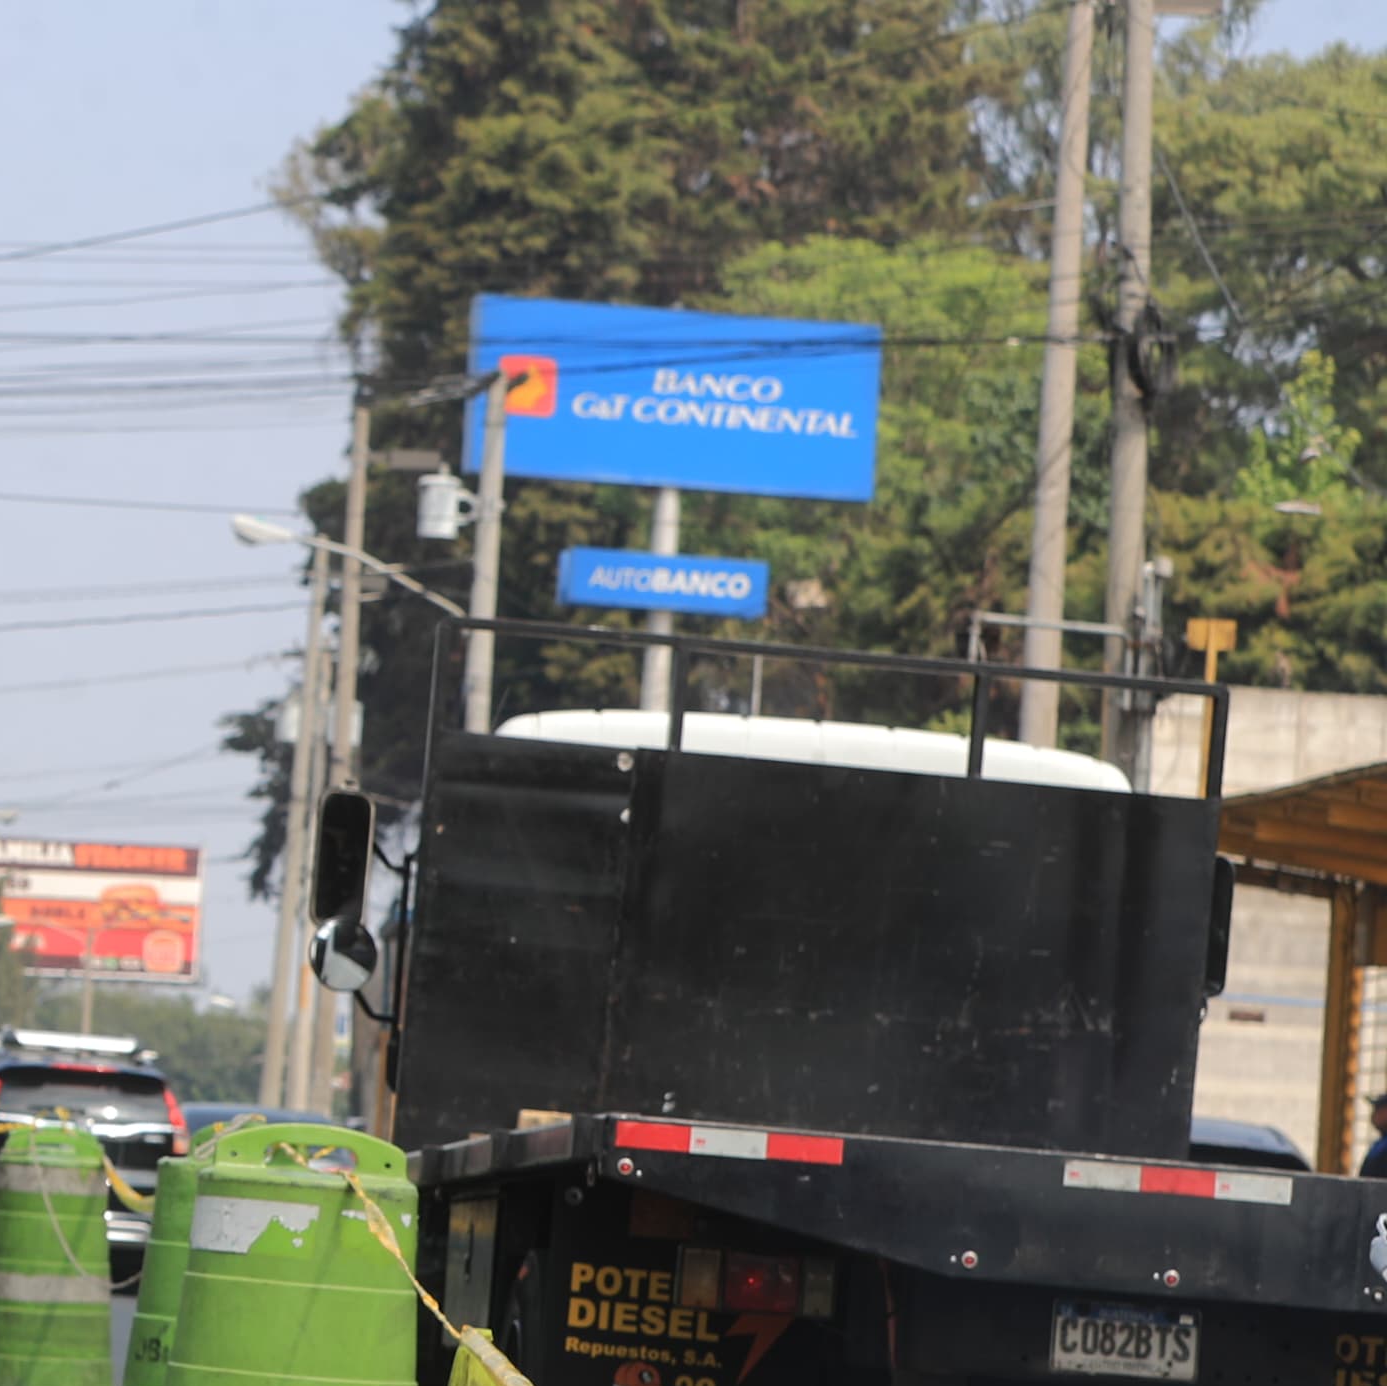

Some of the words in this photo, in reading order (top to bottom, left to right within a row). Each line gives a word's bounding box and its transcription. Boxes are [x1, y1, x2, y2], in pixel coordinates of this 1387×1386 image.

[652, 367, 783, 403] BANCO
[631, 396, 858, 438] CONTINENTAL
[588, 565, 752, 599] AUTOBANCO
[566, 1296, 720, 1343] DIESEL
[564, 1335, 677, 1366] Repuestos,
[682, 1350, 723, 1369] S.A.
